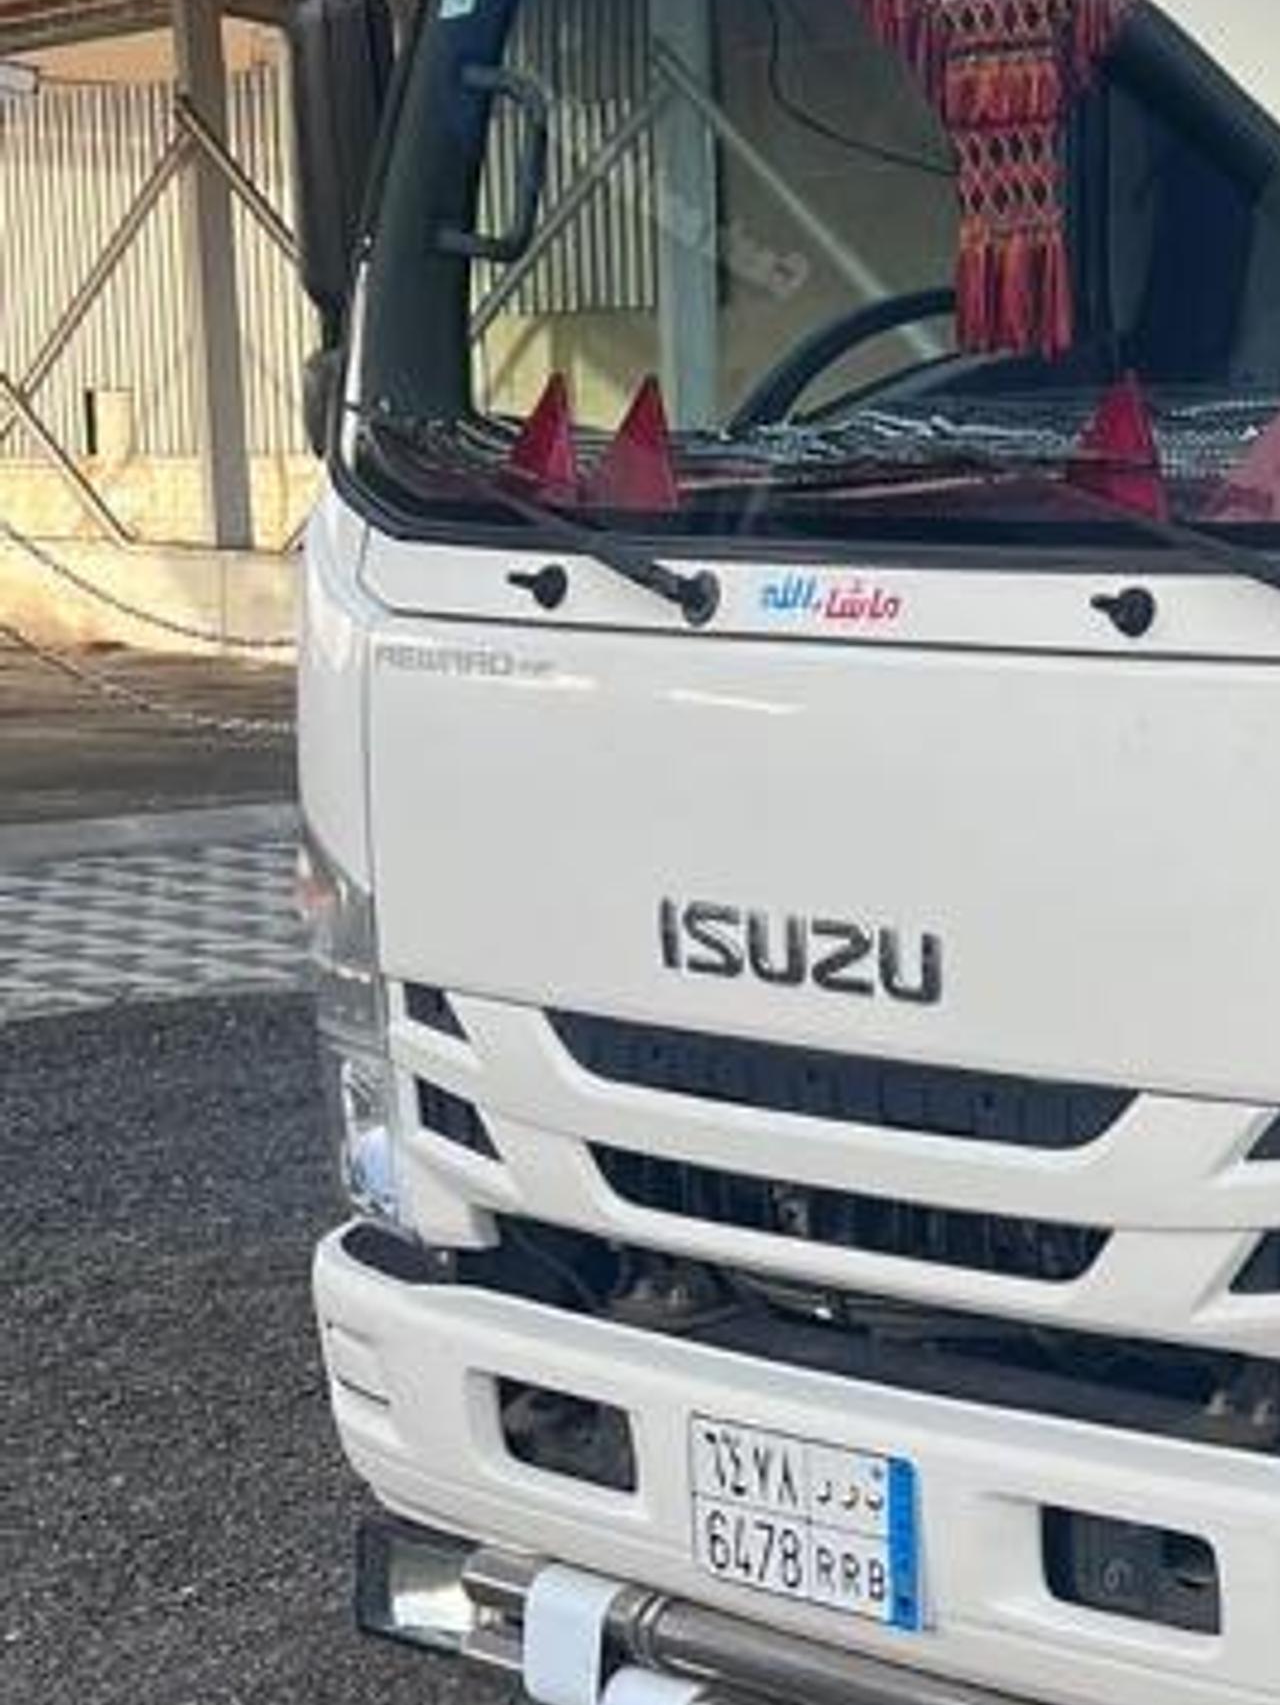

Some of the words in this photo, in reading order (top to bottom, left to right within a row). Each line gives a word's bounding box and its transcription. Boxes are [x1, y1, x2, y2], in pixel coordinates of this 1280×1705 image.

[761, 572, 817, 610] الله
[657, 896, 945, 1006] ISUZU
[706, 1509, 804, 1589] 6478
